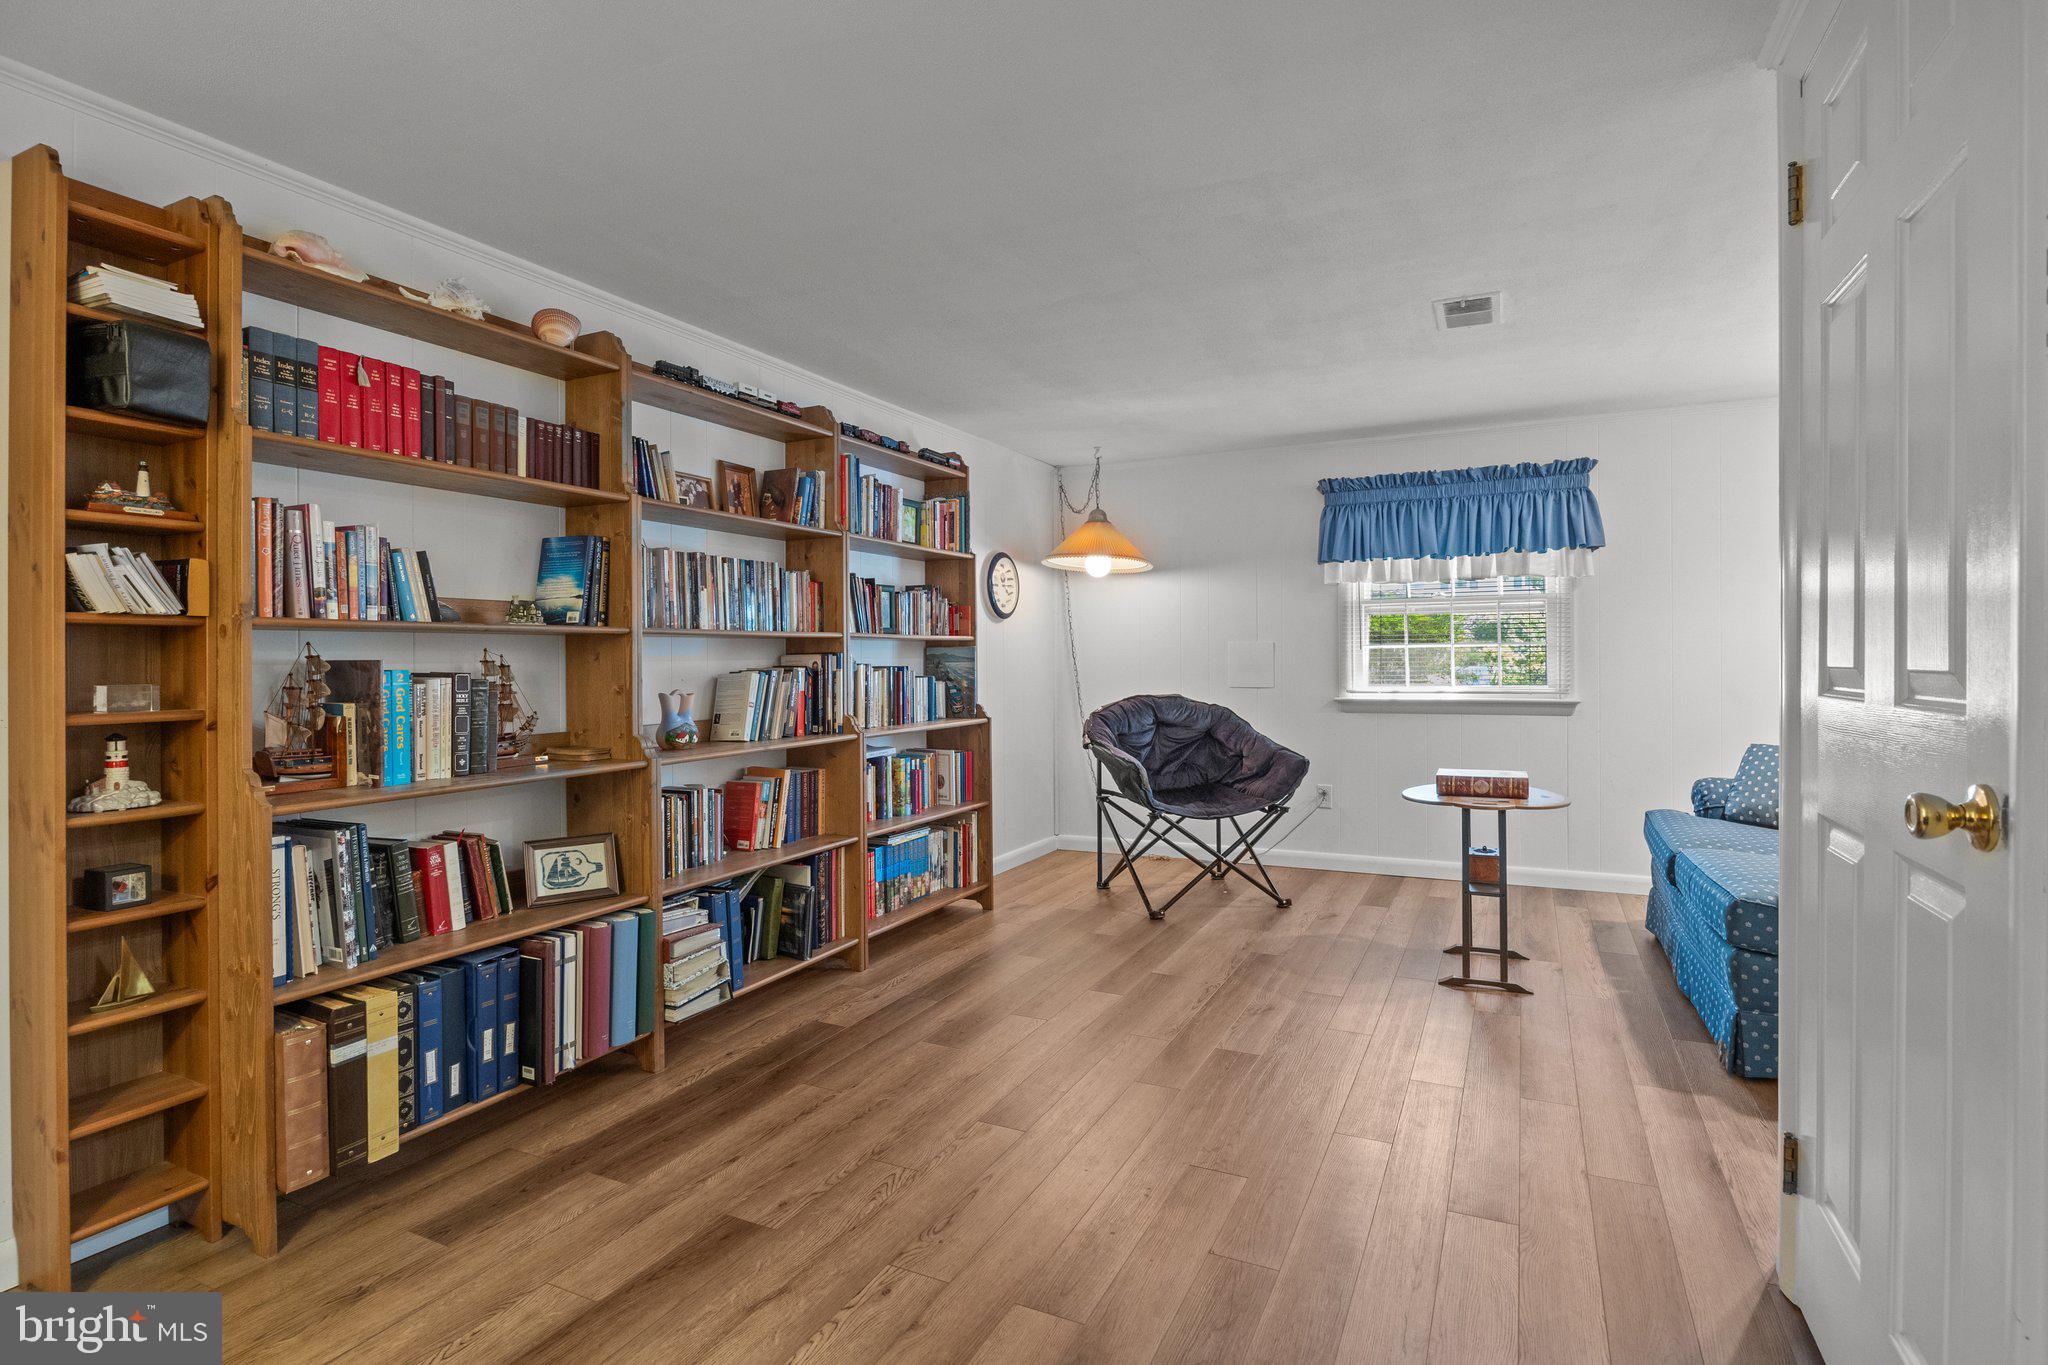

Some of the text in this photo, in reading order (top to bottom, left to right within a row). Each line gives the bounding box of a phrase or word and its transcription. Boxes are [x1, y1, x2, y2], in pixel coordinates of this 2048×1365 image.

[253, 355, 271, 366] Index
[277, 362, 294, 371] Index
[301, 366, 317, 376] Index
[291, 534, 301, 560] Quiet
[396, 674, 406, 749] 2 God Cares
[272, 868, 281, 921] STRONG'S
